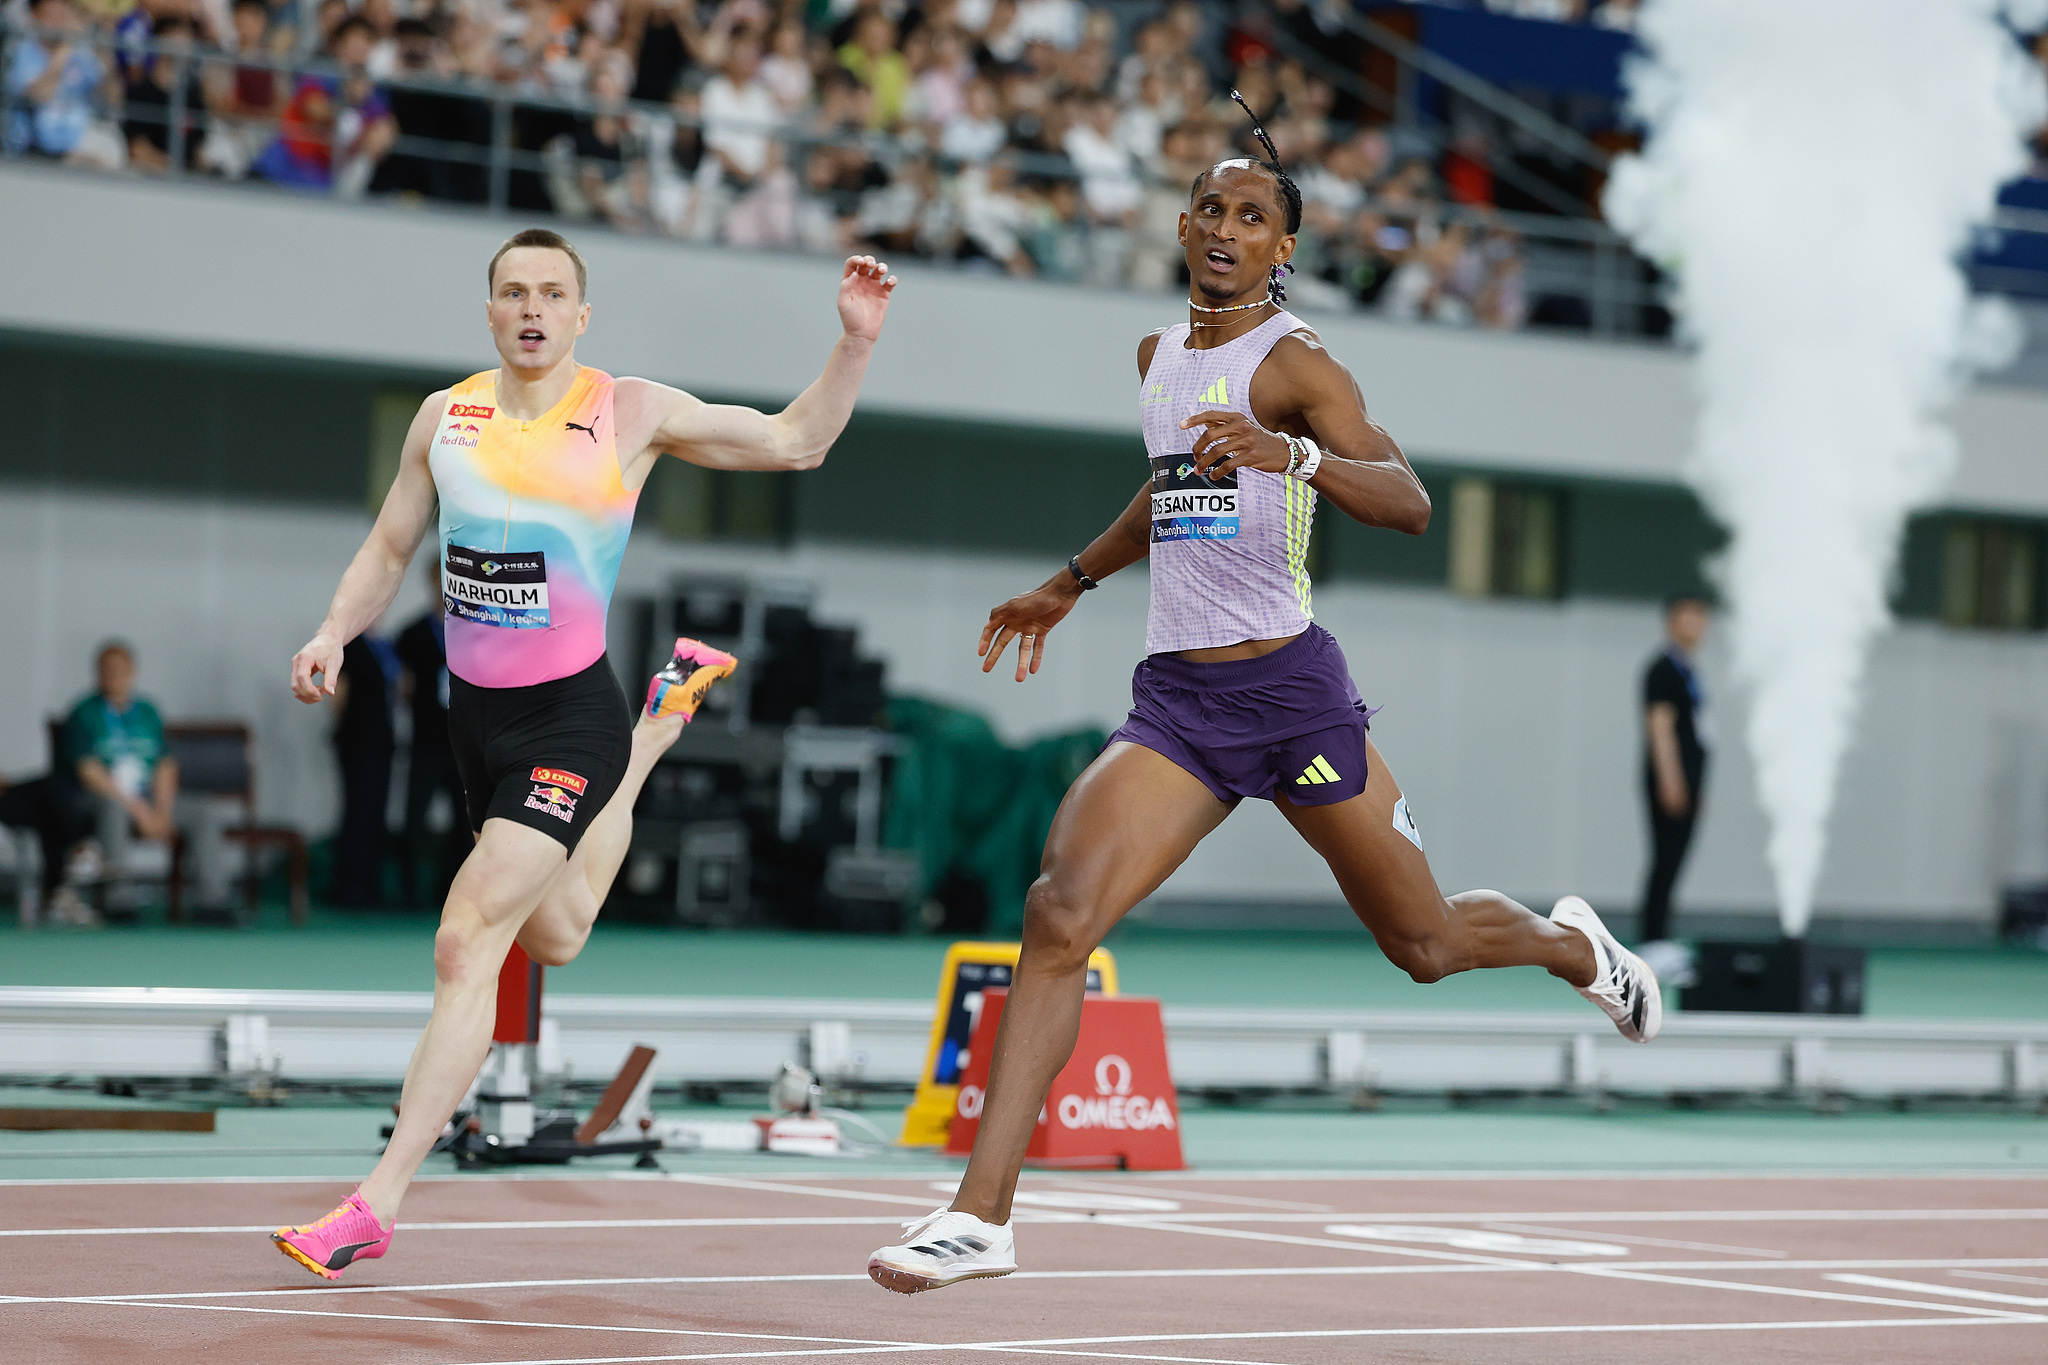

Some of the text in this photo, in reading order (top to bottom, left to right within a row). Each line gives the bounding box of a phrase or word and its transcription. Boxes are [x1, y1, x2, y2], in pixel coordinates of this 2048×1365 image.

[440, 435, 479, 448] Red Bull
[1164, 495, 1236, 514] SANTOS
[1156, 523, 1190, 537] Shanghai
[1196, 523, 1236, 536] keqiao
[446, 576, 539, 605] WARHOLM
[457, 604, 500, 623] Shanghai
[508, 613, 547, 625] keqiao
[552, 773, 580, 789] EXTRA
[525, 796, 574, 823] Red Bull
[1058, 1094, 1176, 1131] OMEGA
